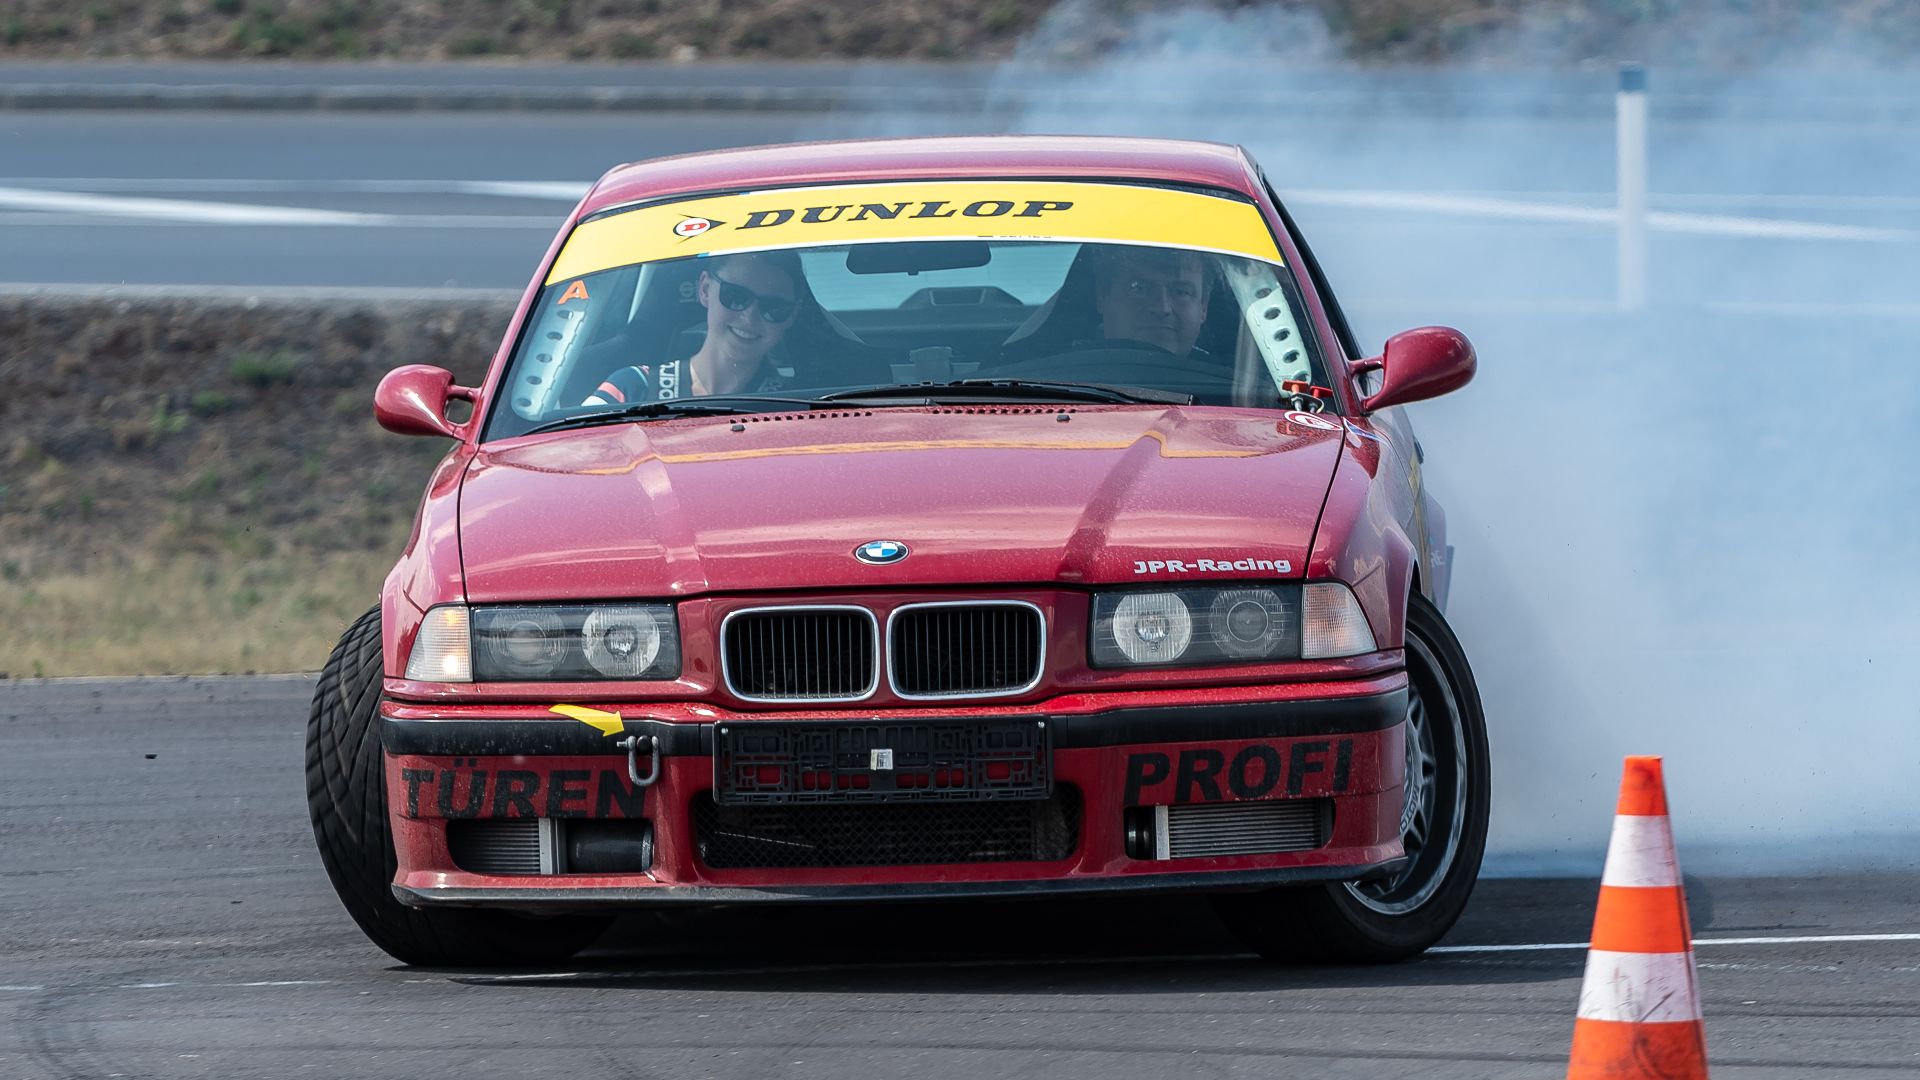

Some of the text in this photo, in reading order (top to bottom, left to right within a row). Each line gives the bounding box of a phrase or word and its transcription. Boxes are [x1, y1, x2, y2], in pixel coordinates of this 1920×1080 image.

[735, 201, 1074, 230] DUNLOP
[558, 280, 589, 304] A
[1134, 558, 1292, 574] JPR-Racing
[1123, 739, 1354, 805] PROFI
[402, 758, 648, 818] TÜREN
